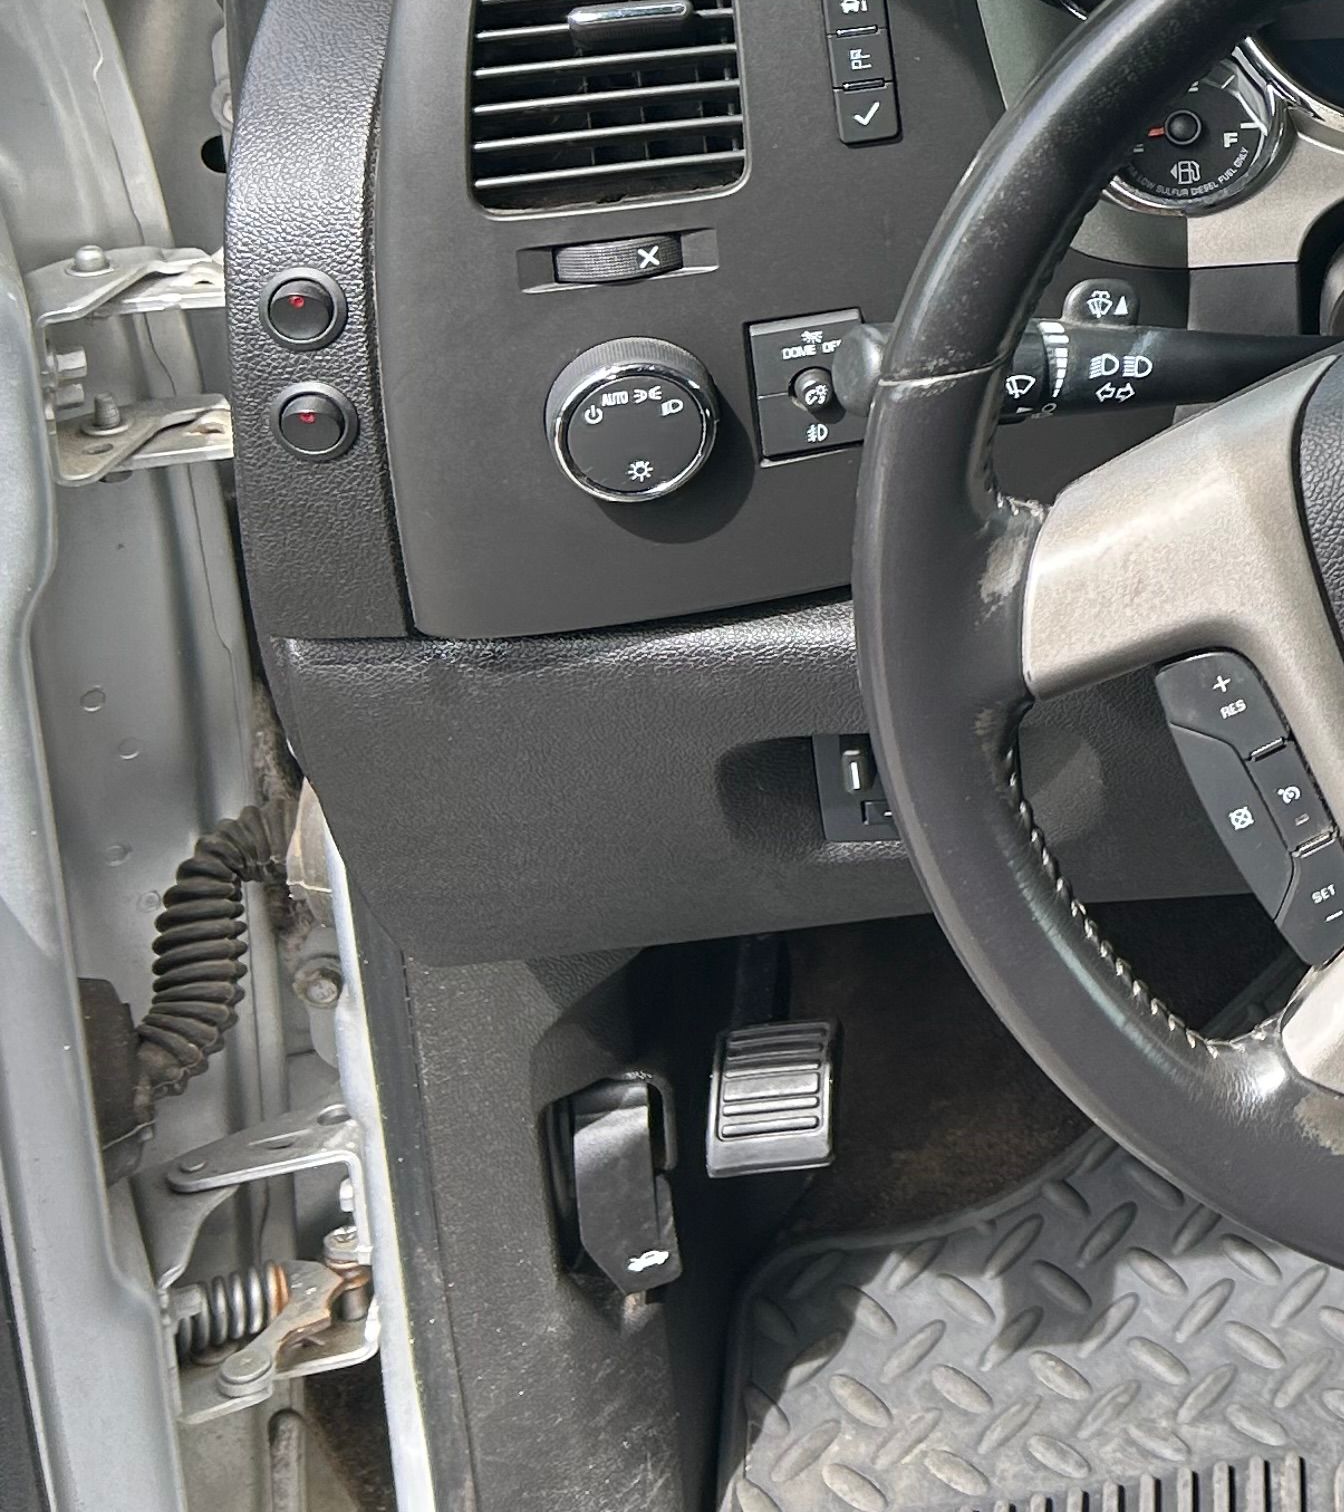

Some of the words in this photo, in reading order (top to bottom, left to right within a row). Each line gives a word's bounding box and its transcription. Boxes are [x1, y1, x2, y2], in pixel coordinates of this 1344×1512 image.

[1223, 132, 1238, 148] F
[1218, 168, 1238, 185] FUEL
[782, 344, 817, 360] DOME
[601, 390, 629, 407] AUTO
[1219, 698, 1247, 720] RES
[1311, 884, 1336, 904] SET
